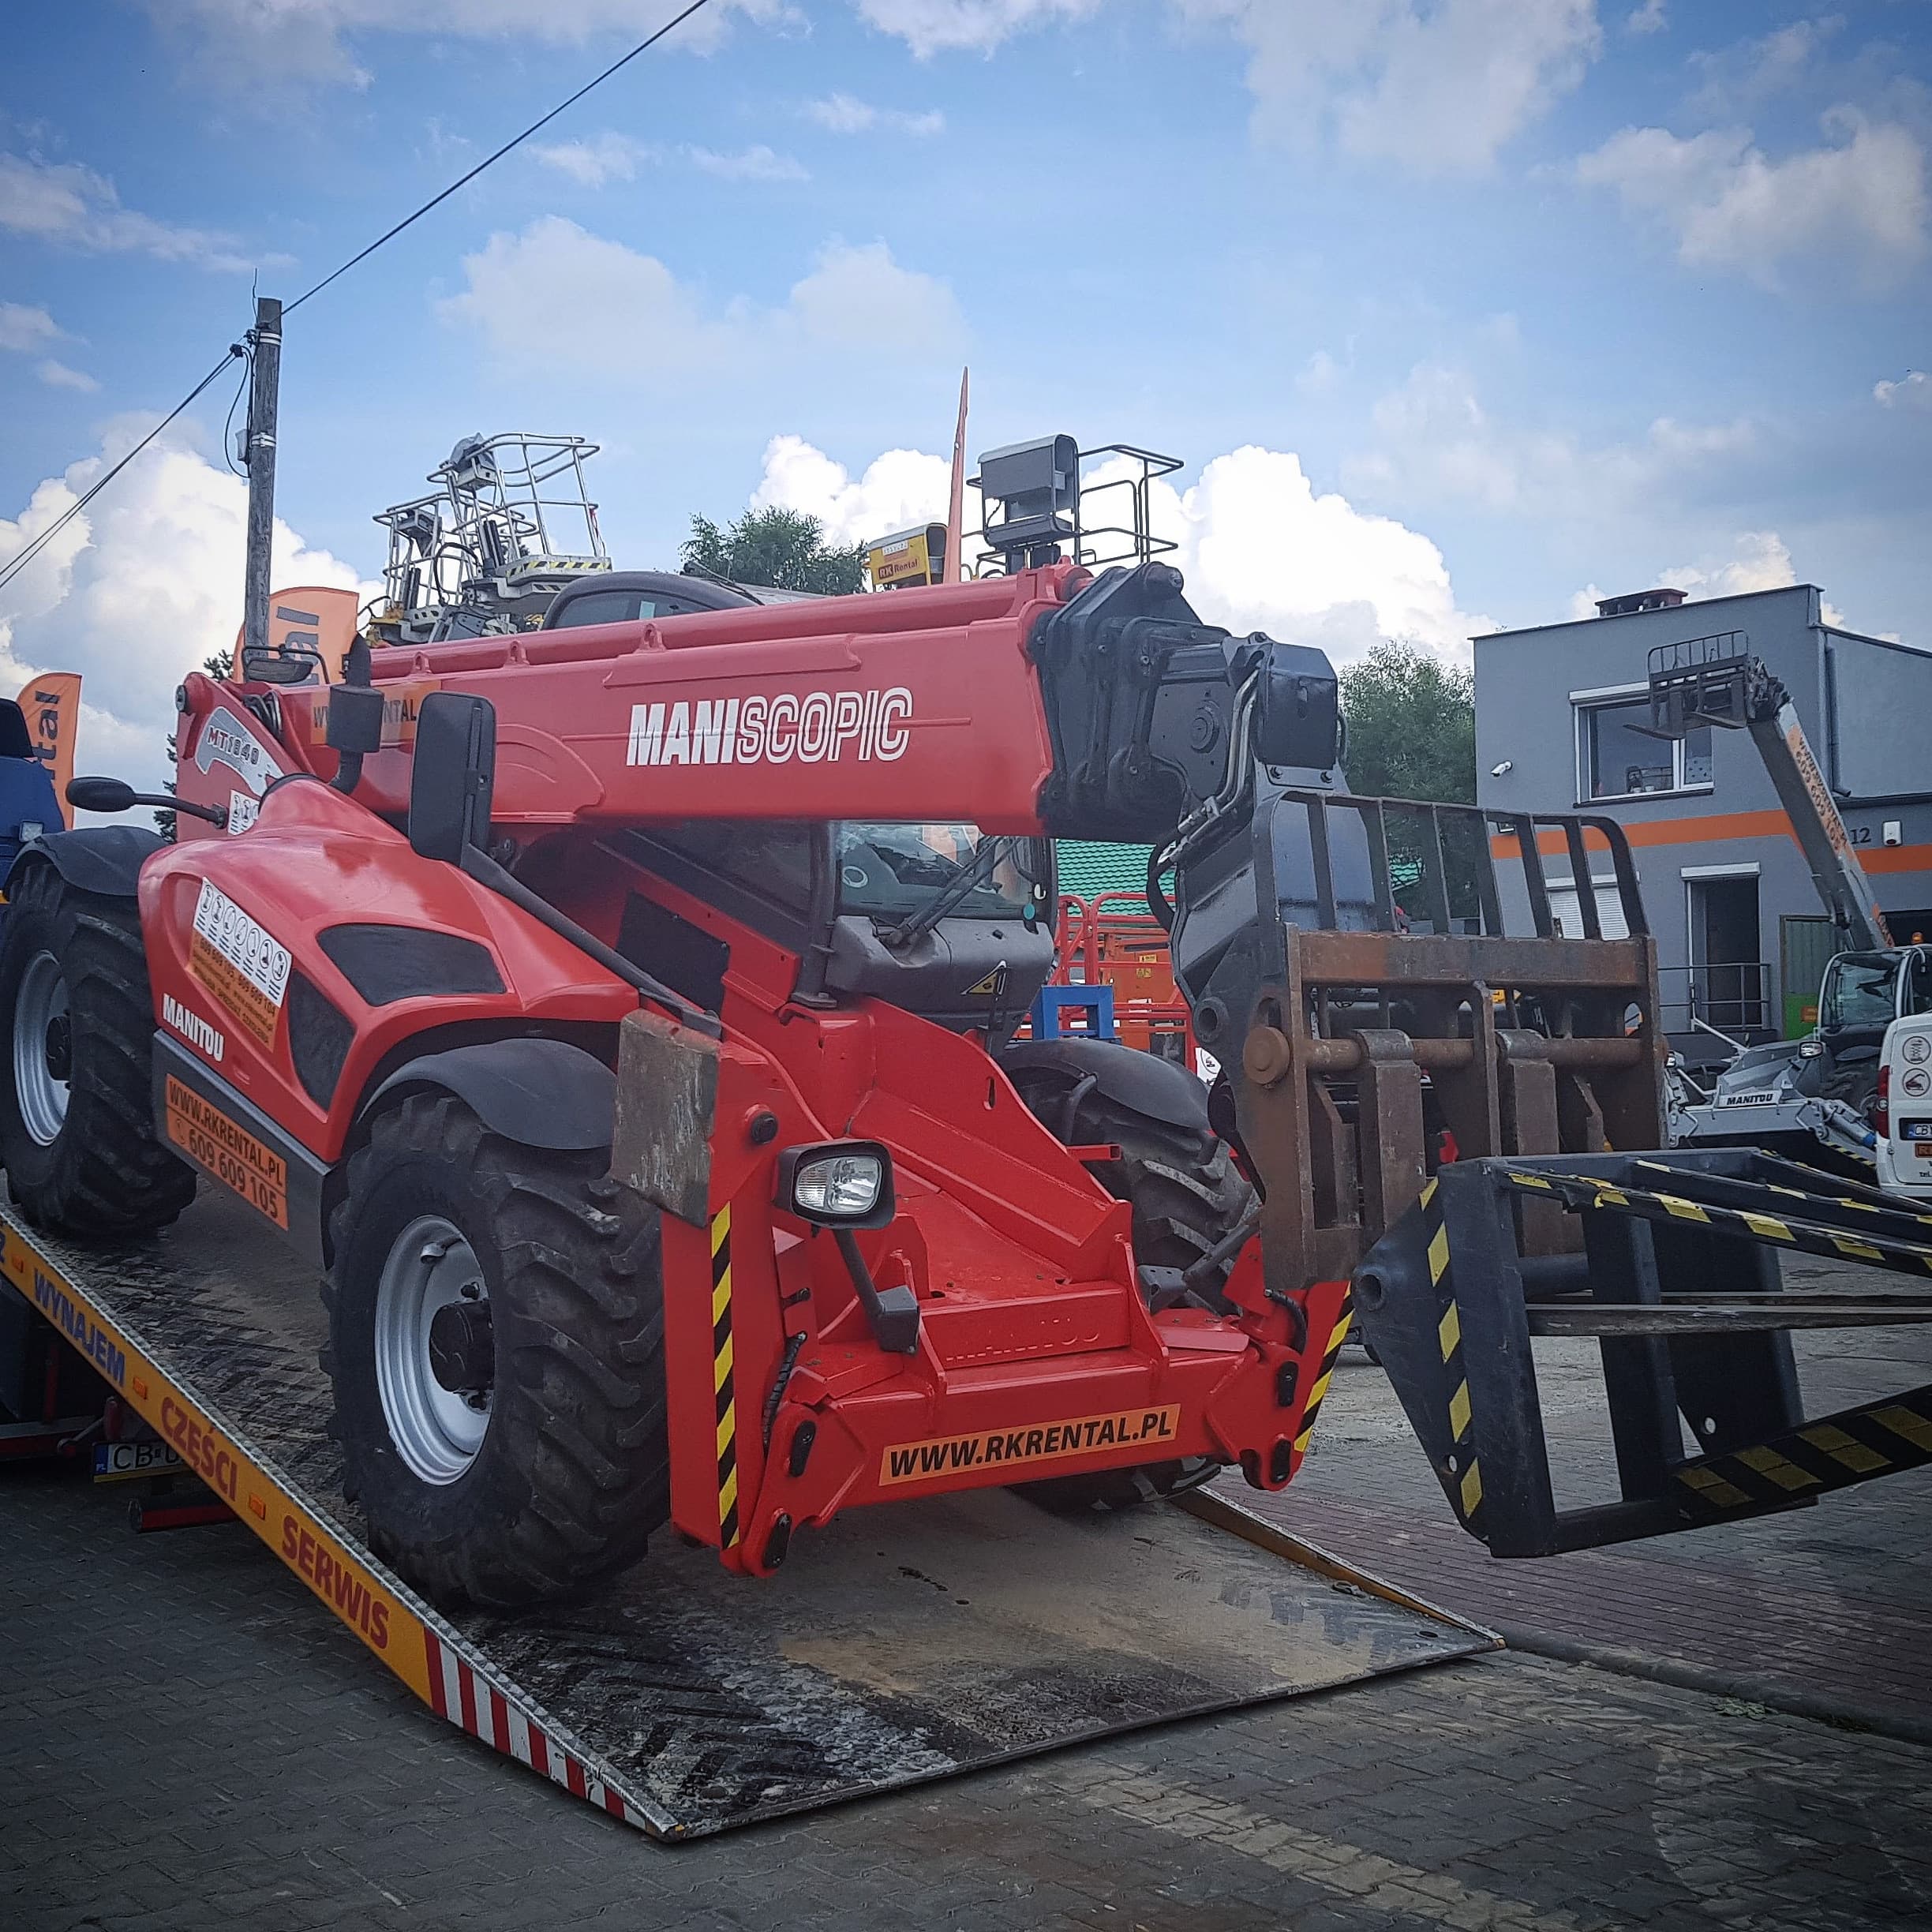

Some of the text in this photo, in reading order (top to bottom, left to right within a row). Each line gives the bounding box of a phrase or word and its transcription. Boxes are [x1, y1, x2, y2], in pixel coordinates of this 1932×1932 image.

[894, 559, 918, 574] Rental
[626, 687, 913, 766] MANISCOPIC
[1850, 827, 1871, 844] 12
[163, 993, 224, 1061] MANITOU
[169, 1081, 283, 1186] WWW.RKRENTAL.PL
[1727, 1094, 1773, 1106] MANITOU
[189, 1129, 279, 1219] 609 609 105
[34, 1267, 125, 1387] WYNAJEM
[162, 1396, 237, 1503] CZĘŚCI
[890, 1411, 1171, 1478] WWW.RKRENTAL.PL
[282, 1515, 389, 1649] SERWIS
